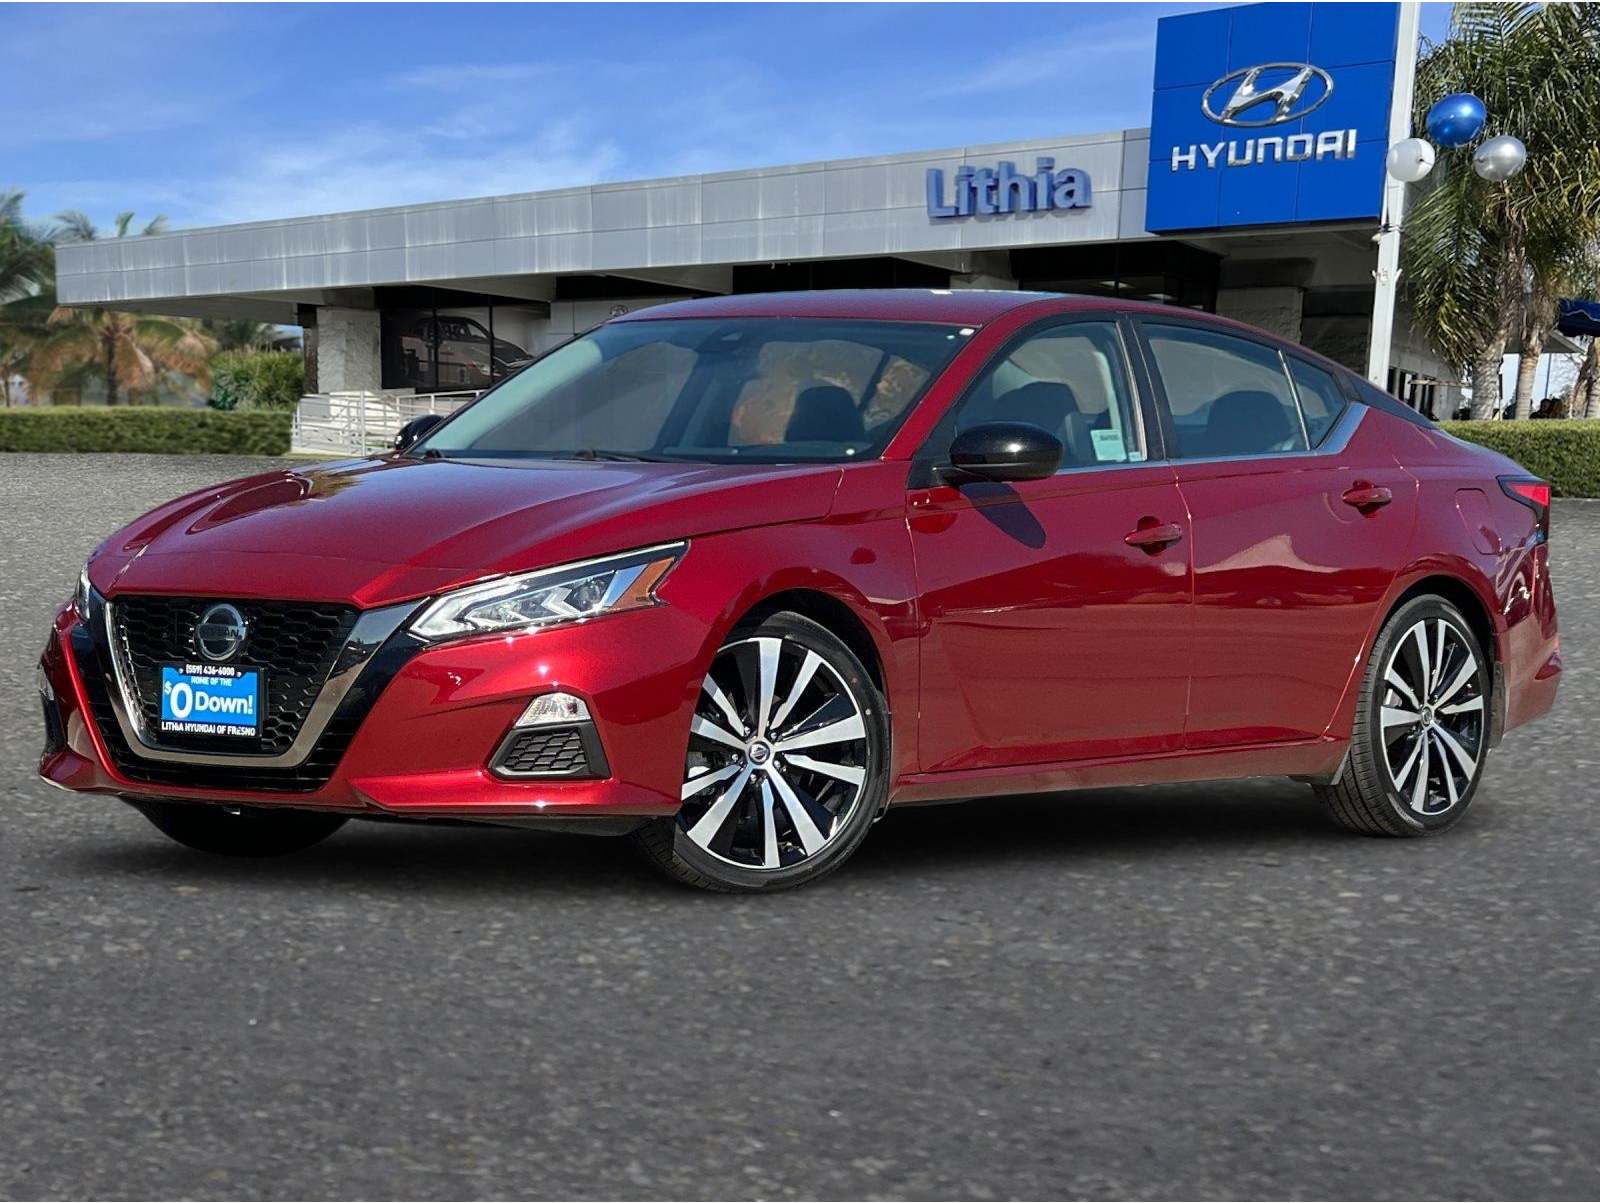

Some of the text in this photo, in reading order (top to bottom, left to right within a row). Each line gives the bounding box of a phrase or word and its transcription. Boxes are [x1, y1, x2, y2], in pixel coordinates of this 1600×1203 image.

[1171, 129, 1358, 171] HYUNDAI
[926, 157, 1092, 219] Lithia
[186, 665, 202, 675] (559)
[164, 681, 253, 719] $0 Down!
[162, 722, 255, 736] LITHIA HYUNDAI OF FRESNO
